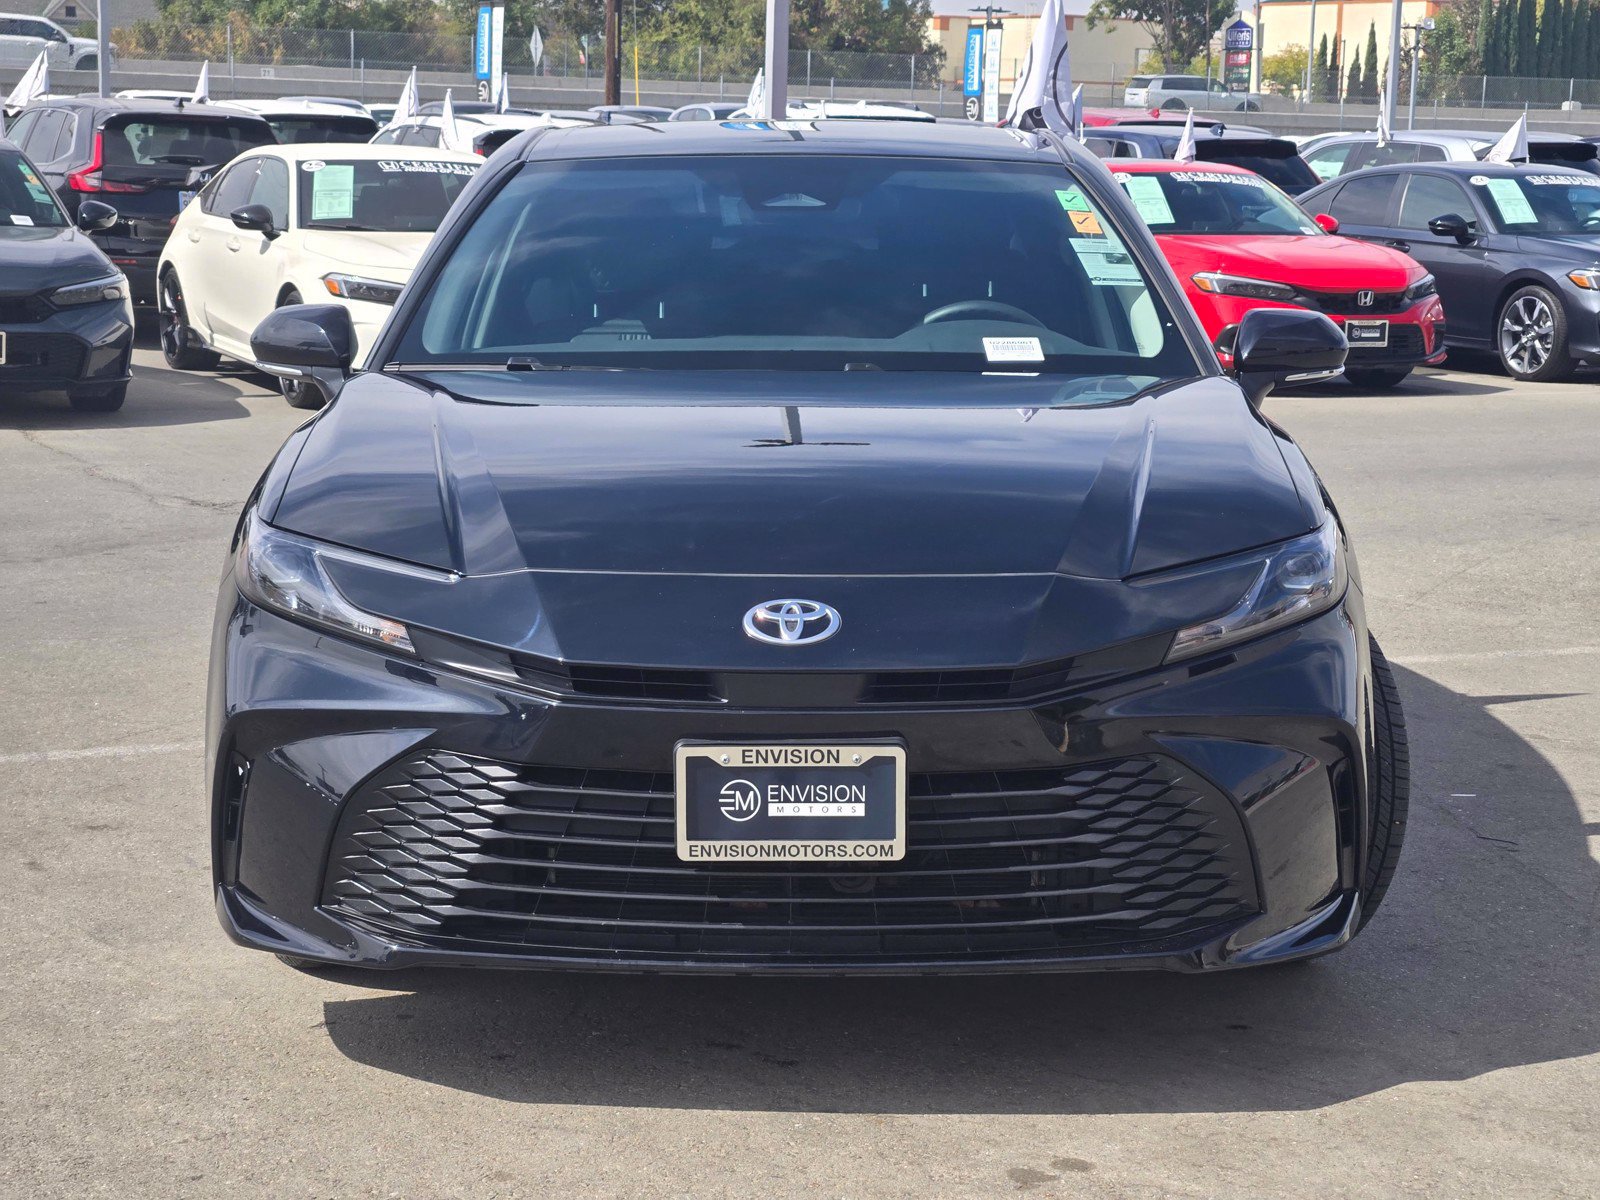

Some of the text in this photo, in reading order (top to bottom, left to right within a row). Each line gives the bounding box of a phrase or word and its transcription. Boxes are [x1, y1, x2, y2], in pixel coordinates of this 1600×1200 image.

[967, 34, 977, 91] ENVISION
[741, 749, 840, 764] ENVISION
[767, 784, 866, 802] ENVISION
[776, 805, 857, 813] MOTORS
[689, 844, 894, 858] ENVISIONMOTORS.COM
